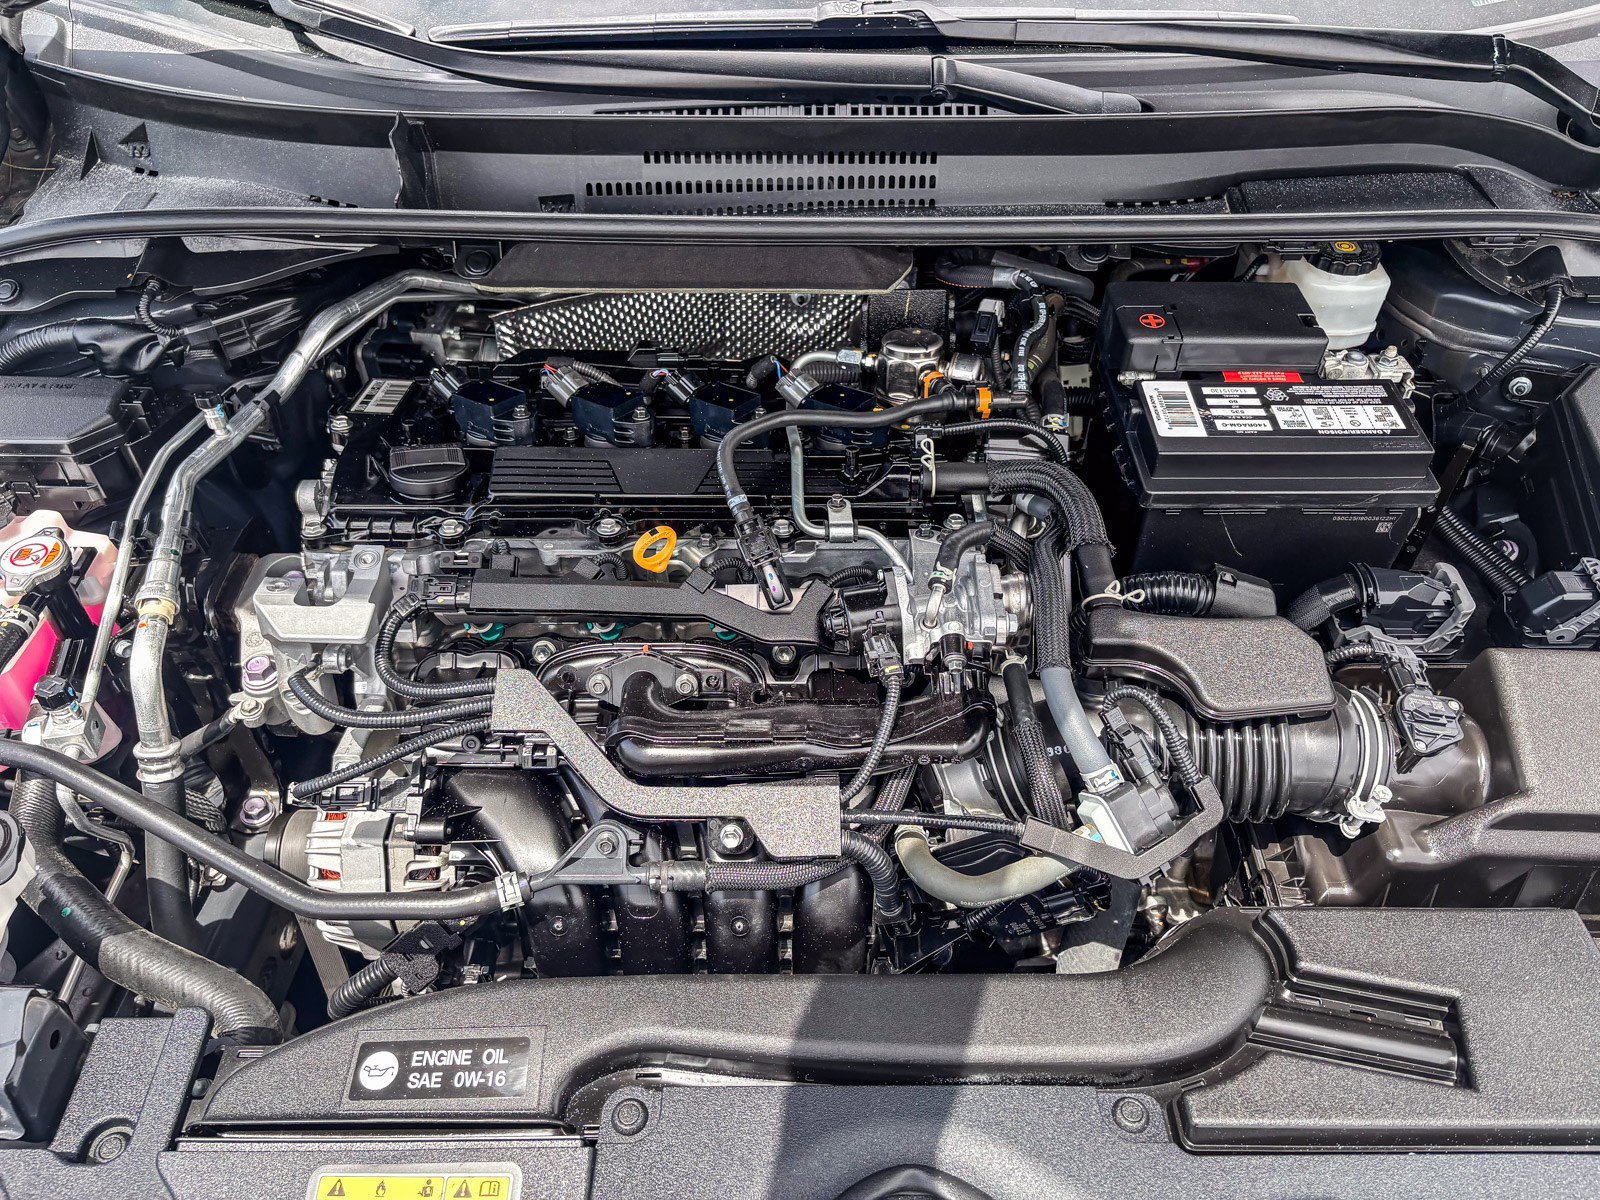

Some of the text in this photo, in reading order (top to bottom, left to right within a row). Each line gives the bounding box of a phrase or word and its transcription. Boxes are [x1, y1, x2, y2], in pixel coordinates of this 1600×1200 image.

[411, 1048, 509, 1067] ENGINE OIL
[407, 1071, 507, 1089] SAE 0W-16
